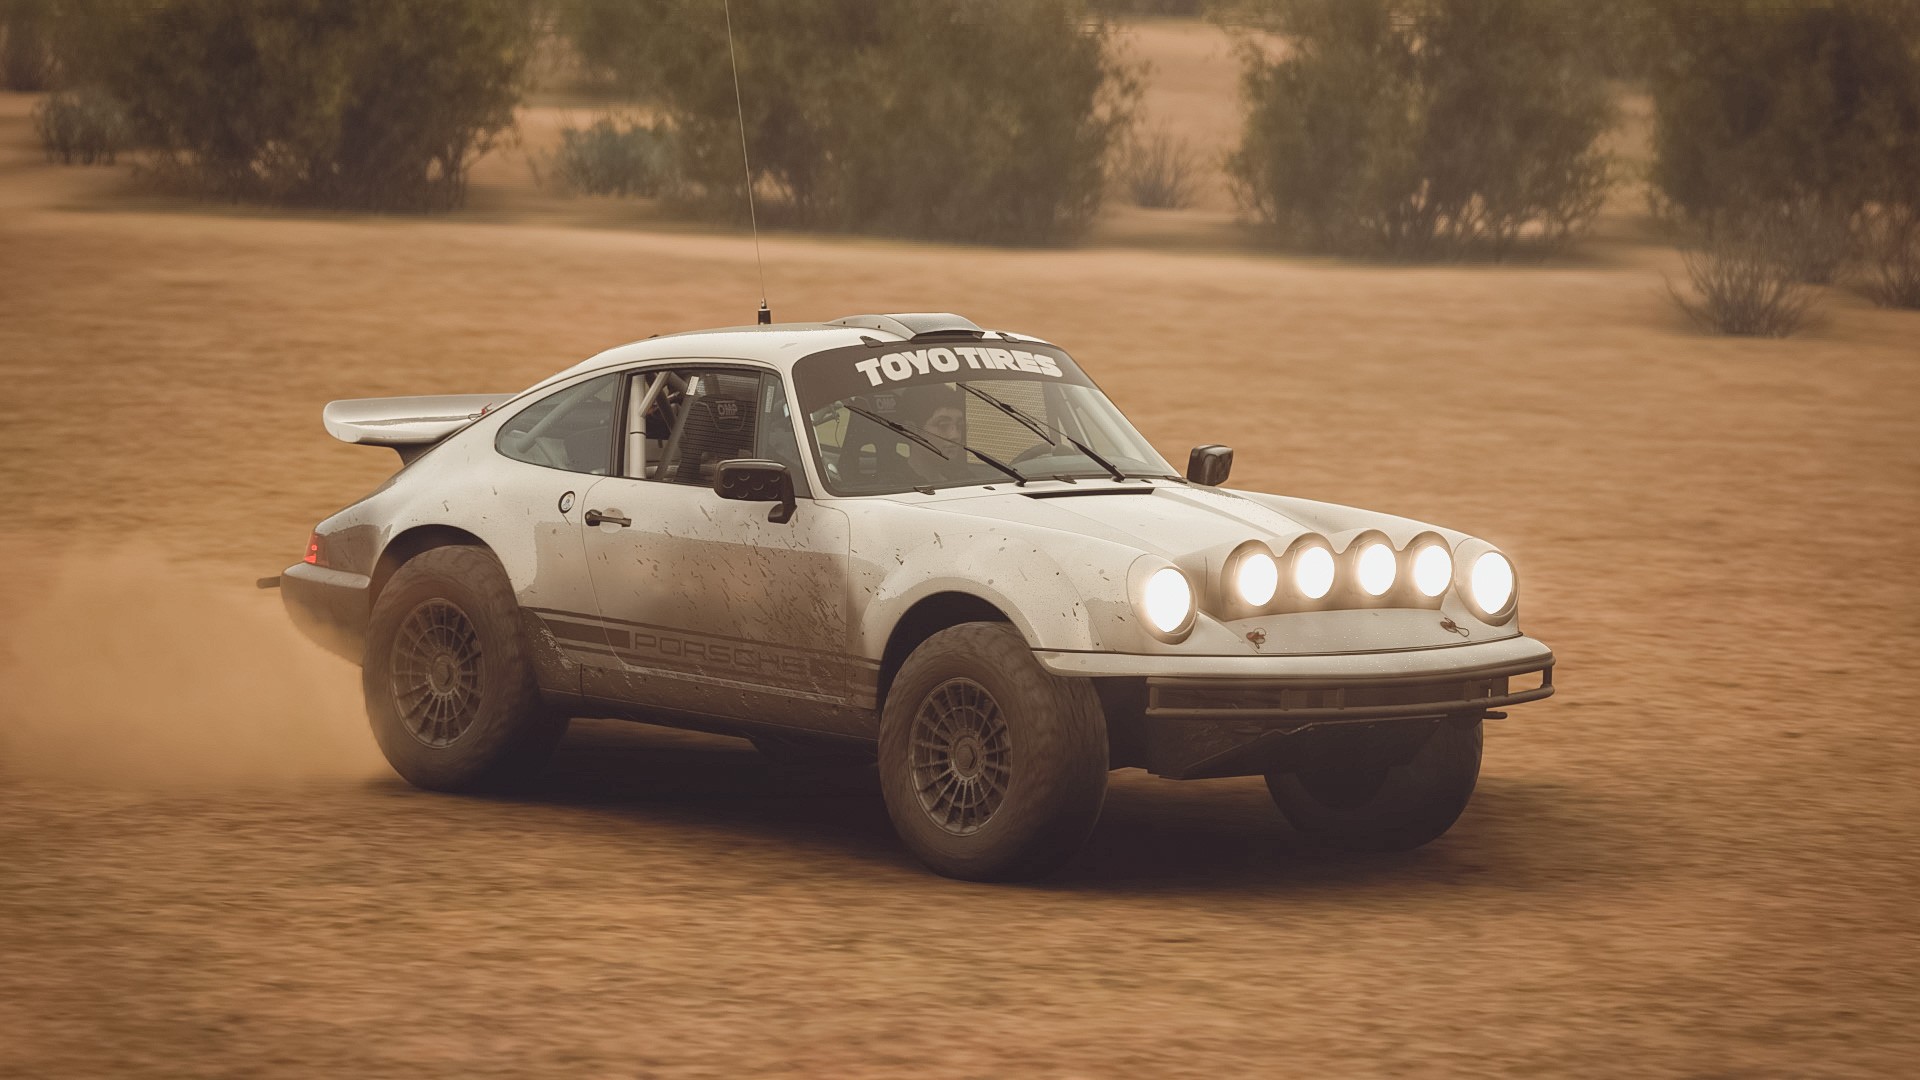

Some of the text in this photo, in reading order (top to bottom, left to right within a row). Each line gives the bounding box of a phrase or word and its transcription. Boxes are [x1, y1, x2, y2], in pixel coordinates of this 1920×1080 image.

[855, 347, 1063, 386] TOYO TIRES
[717, 403, 738, 416] OMP
[634, 634, 809, 673] PORSCHE
